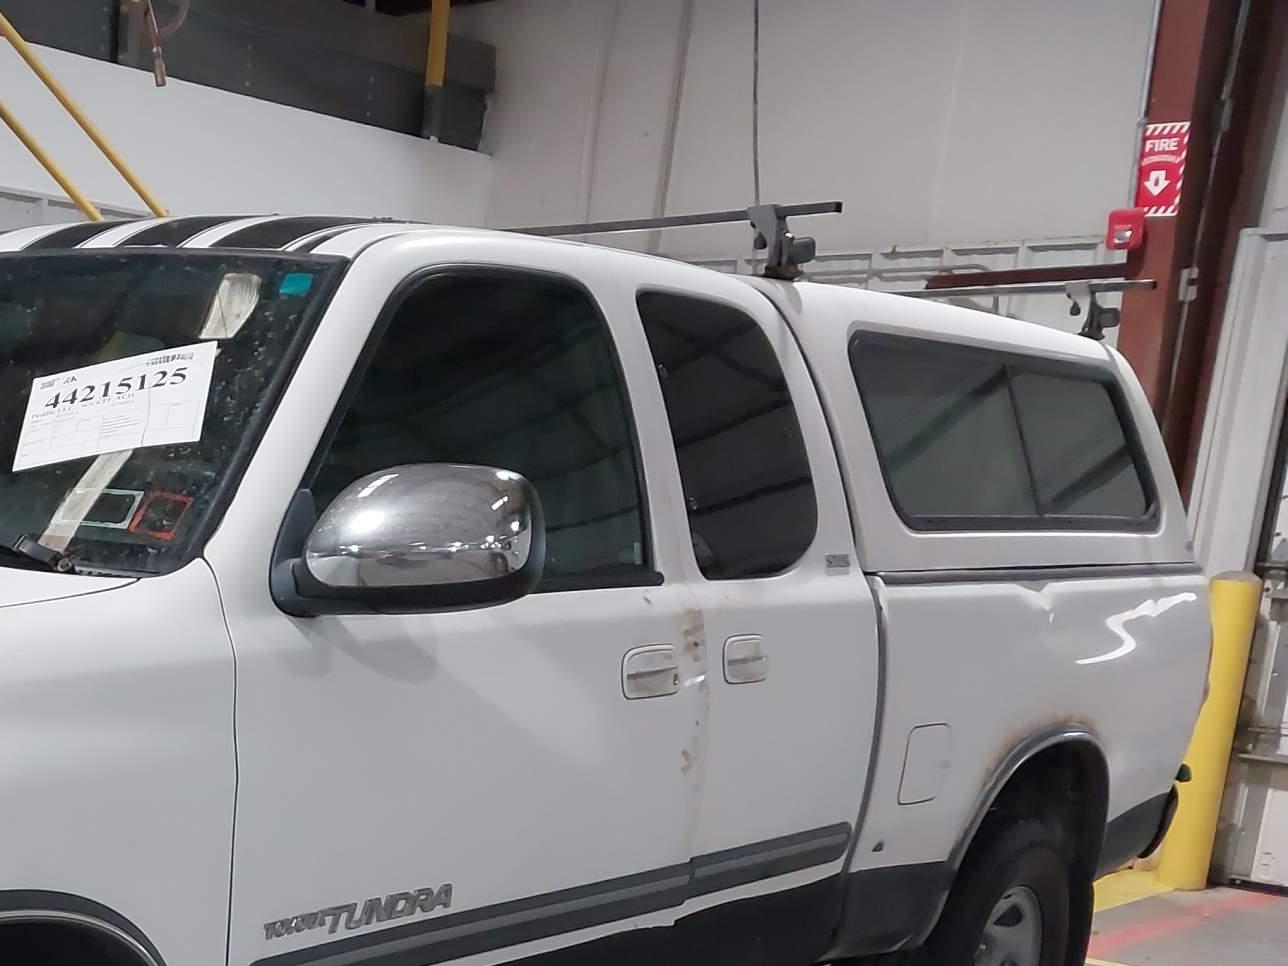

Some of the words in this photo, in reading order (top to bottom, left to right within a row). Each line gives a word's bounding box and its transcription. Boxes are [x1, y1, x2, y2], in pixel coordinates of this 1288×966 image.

[1144, 137, 1180, 152] FIRE
[44, 367, 189, 409] 44215125
[319, 883, 454, 934] TUNDRA
